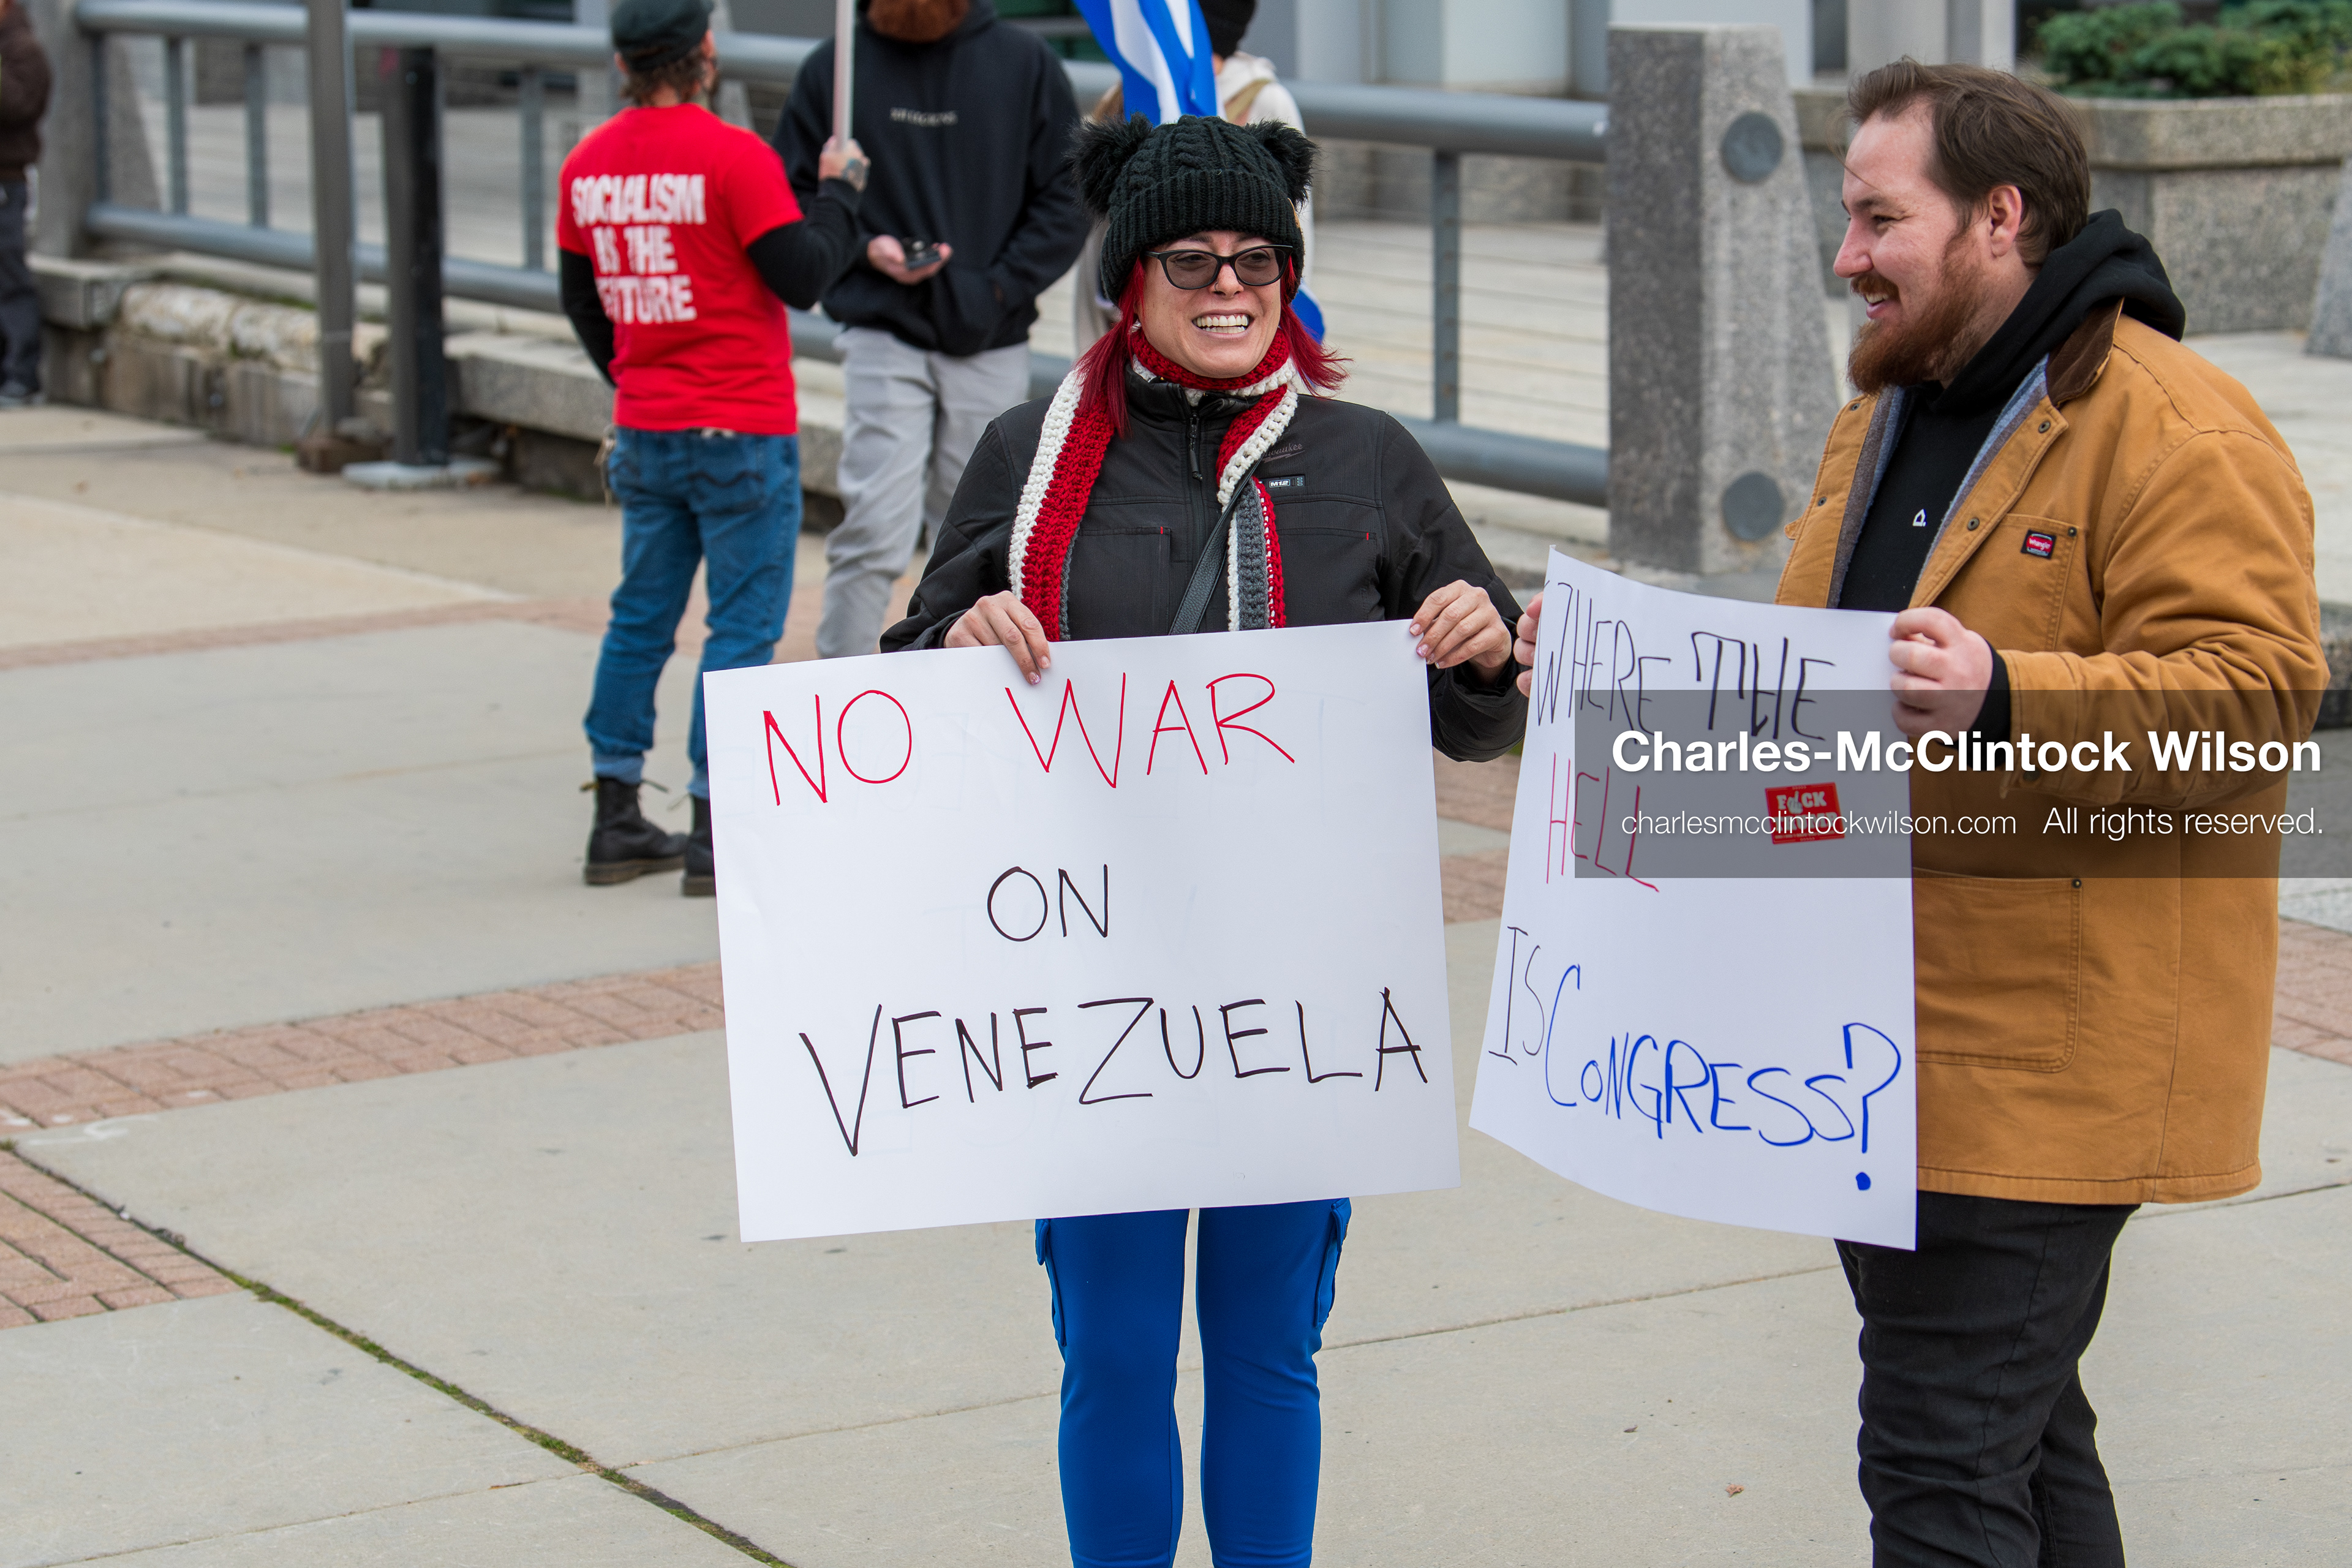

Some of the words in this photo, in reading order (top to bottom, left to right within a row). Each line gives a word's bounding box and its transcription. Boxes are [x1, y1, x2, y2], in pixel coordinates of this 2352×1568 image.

[571, 173, 706, 228] SOCIALISM
[592, 226, 620, 274] IS
[624, 225, 677, 274] THE
[1537, 580, 1671, 742] WHERE
[1691, 631, 1836, 741] THE
[763, 689, 912, 806] NO
[1005, 671, 1295, 789] WAR
[1776, 791, 1827, 815] FCK
[1546, 752, 1660, 892] HELL
[986, 864, 1109, 942] ON
[1488, 925, 1545, 1066] IS
[798, 986, 1429, 1156] VENEZUELA
